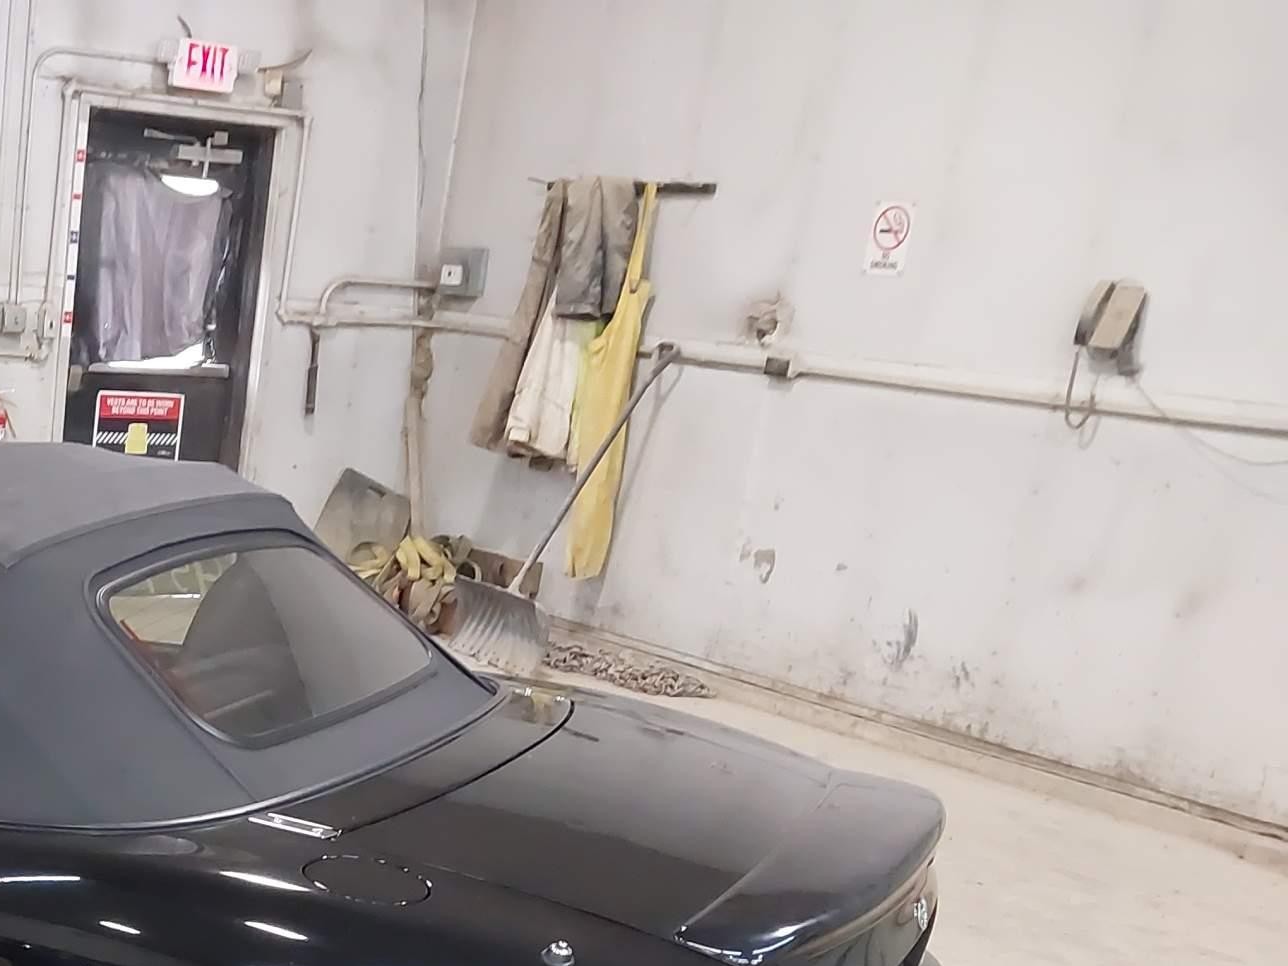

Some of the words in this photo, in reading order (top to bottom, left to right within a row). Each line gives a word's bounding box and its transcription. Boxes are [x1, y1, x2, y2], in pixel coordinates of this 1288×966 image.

[186, 43, 229, 79] EXIT
[107, 397, 126, 407] VESTS
[126, 398, 138, 407] ARE
[149, 407, 169, 417] POINT
